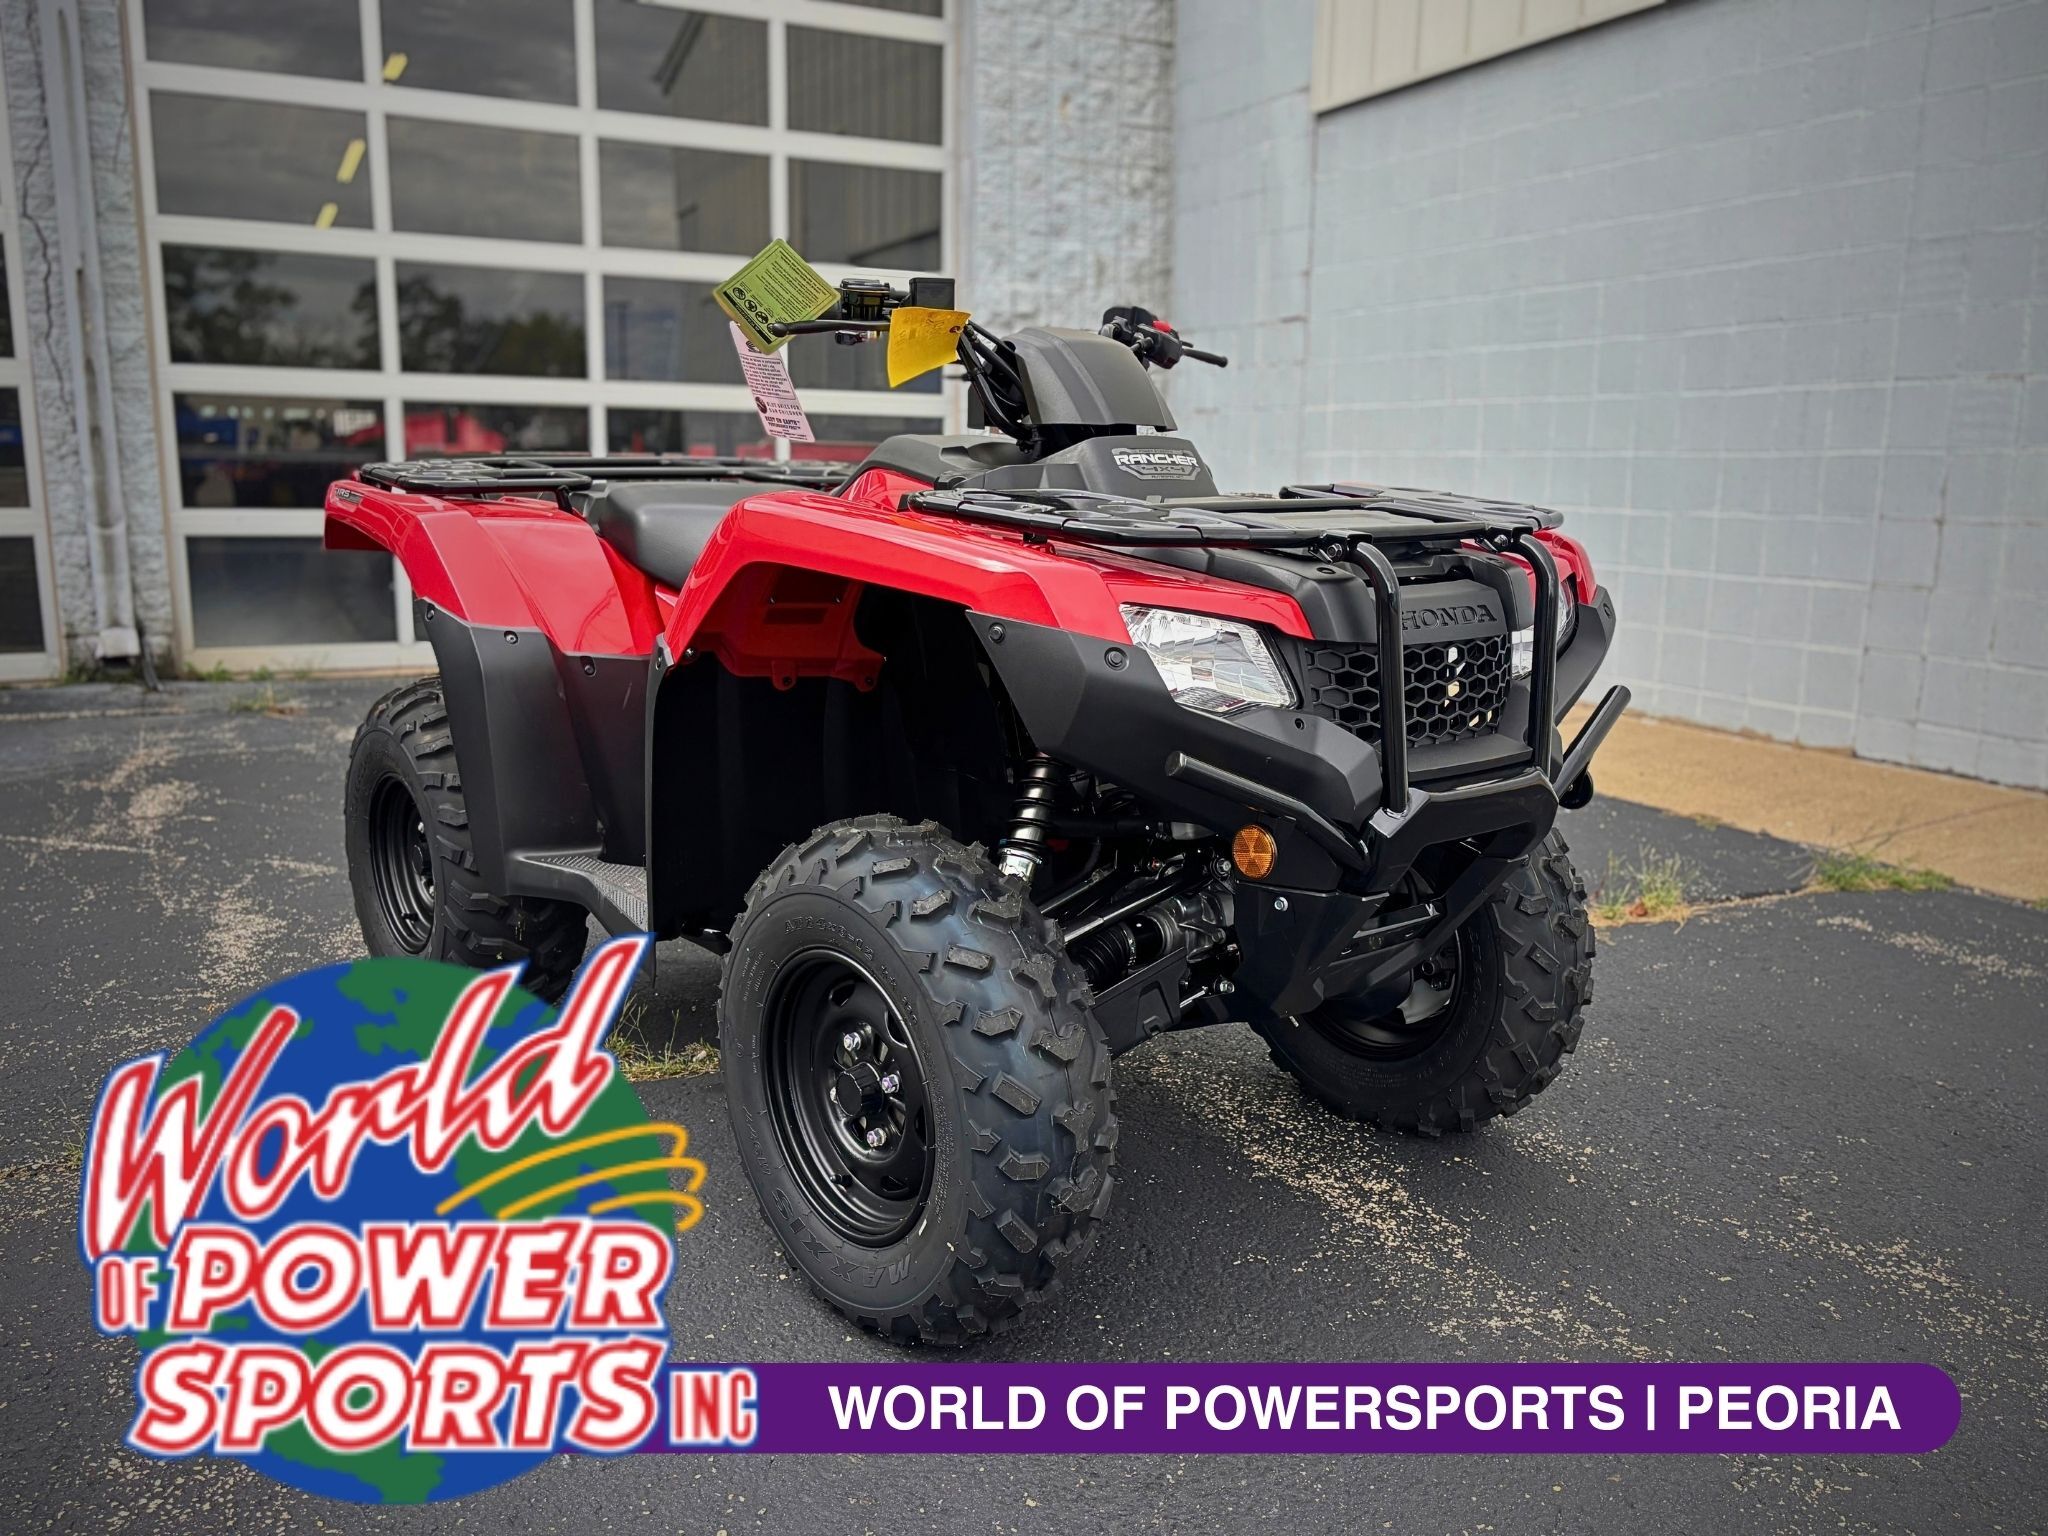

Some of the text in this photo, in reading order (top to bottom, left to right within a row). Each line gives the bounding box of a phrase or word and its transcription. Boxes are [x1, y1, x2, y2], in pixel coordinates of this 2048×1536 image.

[1114, 454, 1198, 467] RANCHER
[1402, 604, 1498, 632] HONDA
[772, 1188, 912, 1288] MAXXIS
